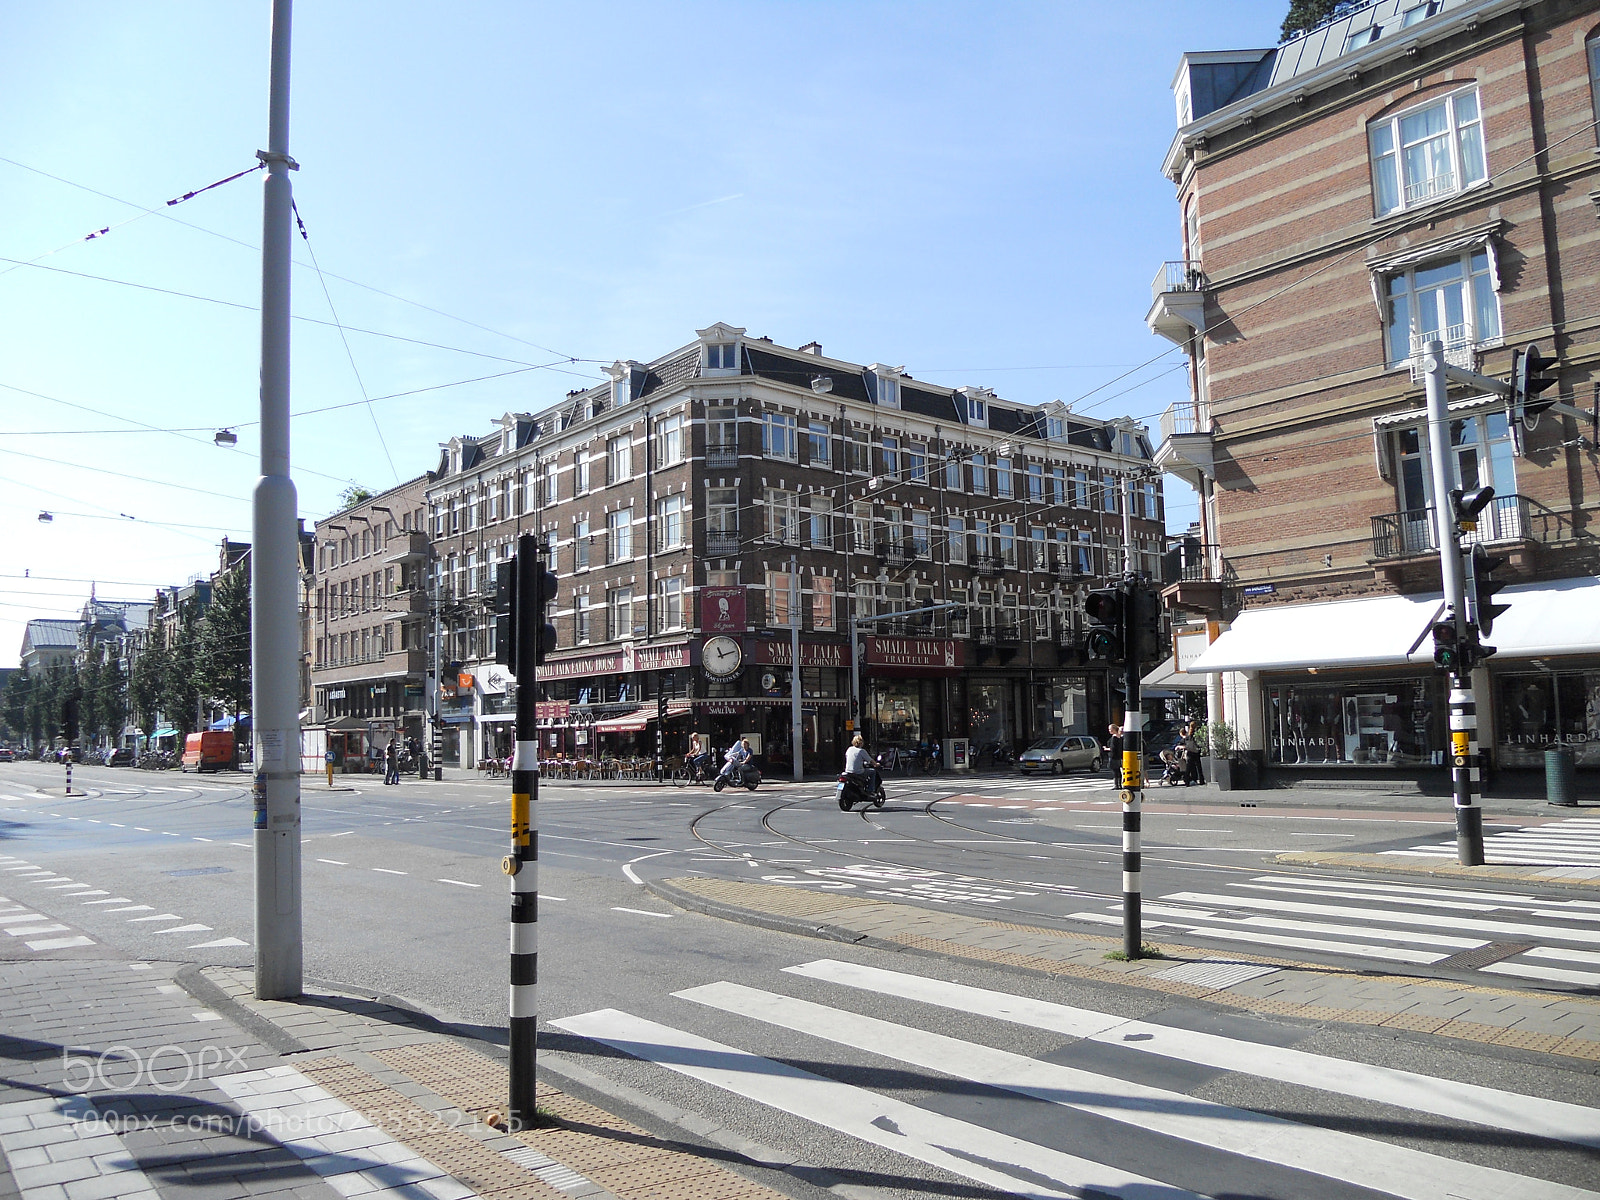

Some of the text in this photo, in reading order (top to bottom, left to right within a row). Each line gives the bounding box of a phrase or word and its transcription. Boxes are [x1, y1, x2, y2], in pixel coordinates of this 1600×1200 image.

[638, 645, 683, 662] SMALL TALK
[768, 642, 841, 659] SMAL TALK
[875, 639, 939, 656] SMALL TALK
[641, 658, 683, 669] COFFEE CORNER
[772, 656, 840, 666] COFFE CORNER
[884, 655, 929, 664] TRAITEUR
[537, 656, 616, 677] SMALL TALK EATING HOUSE
[1273, 738, 1335, 747] LINHARD
[1507, 733, 1588, 745] LINHARD
